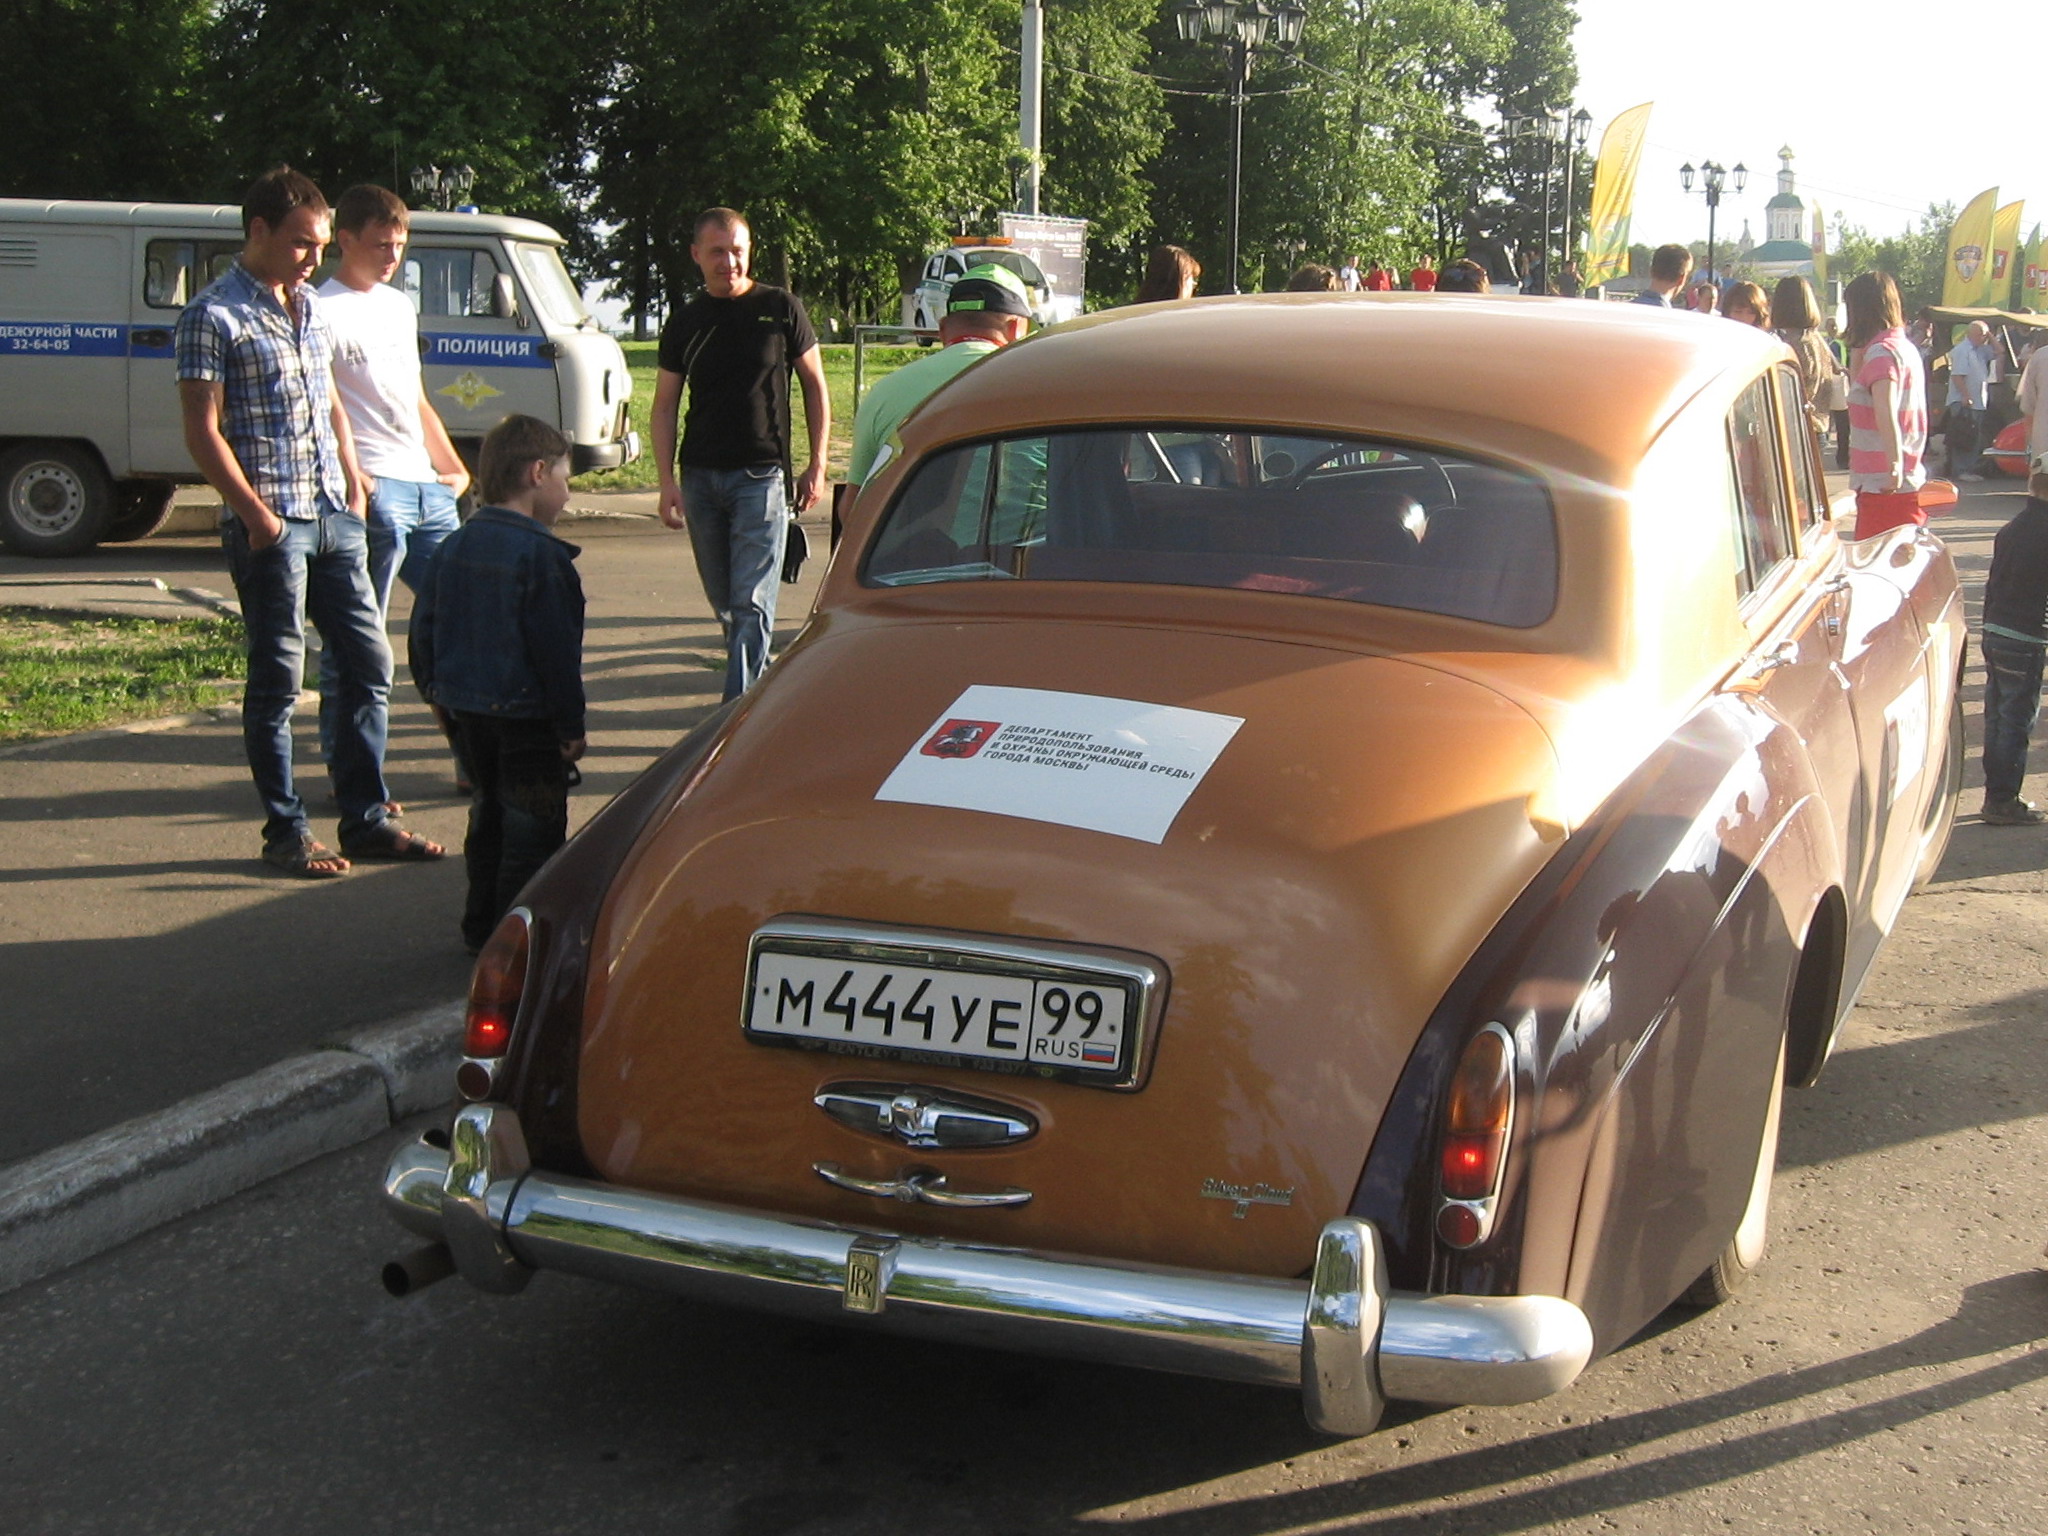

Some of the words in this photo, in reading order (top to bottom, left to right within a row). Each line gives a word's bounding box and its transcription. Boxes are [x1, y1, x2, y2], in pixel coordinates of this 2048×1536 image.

[0, 324, 71, 338] ДЕЖУРНОЙ
[75, 327, 118, 339] ЧАСТИ
[12, 339, 70, 351] 32-64-05
[437, 338, 530, 357] ПОЛИЦИЯ
[1004, 725, 1093, 741] ДЕПАРТАМЕНТ
[998, 733, 1143, 759] ПРИРОДОПОЛЬЗОВАНИЯ
[983, 750, 1031, 763] ГОРОДА
[1033, 757, 1090, 771] МОСКВЫ
[990, 741, 1000, 749] И
[1002, 742, 1053, 756] ОХРАНЫ
[1056, 749, 1148, 770] ОКРУЖАЮЩЕЙ
[1150, 764, 1196, 780] СРЕДЫ
[1042, 987, 1104, 1041] 99
[1034, 1037, 1080, 1059] RUS
